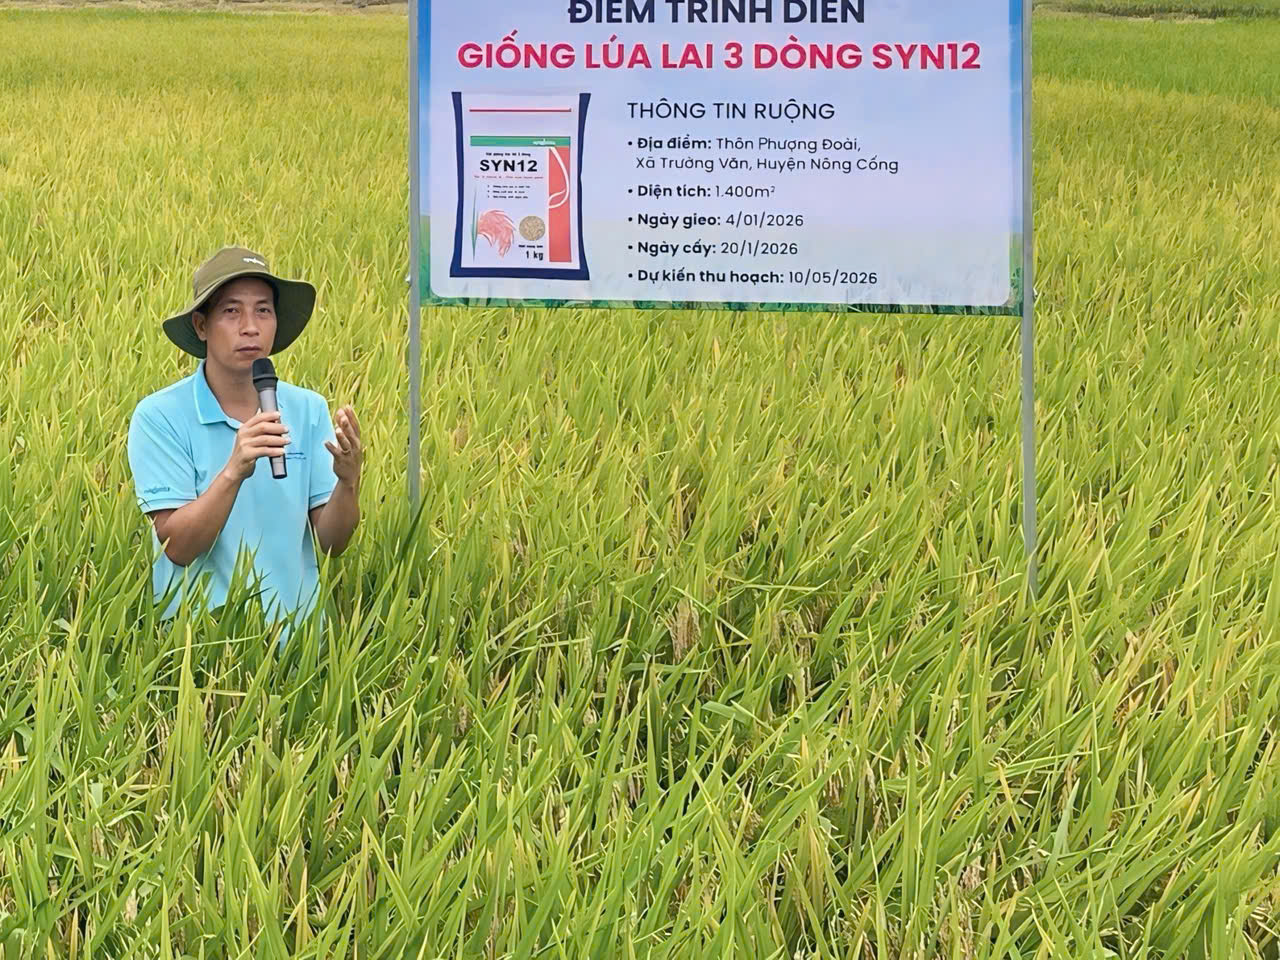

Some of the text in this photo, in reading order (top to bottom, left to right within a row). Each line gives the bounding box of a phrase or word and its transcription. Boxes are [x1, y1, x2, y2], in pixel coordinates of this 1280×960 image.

[457, 30, 982, 70] GIỐNG LÚA LAI 3 DÒNG SYN12
[627, 98, 836, 123] THÔNG TIN RUỘNG
[637, 133, 861, 154] Địa điểm: Thôn Phượng Đoài,
[479, 159, 538, 172] SYN12
[636, 155, 899, 173] Xã Trường Văn, Huyện Nông Cống
[637, 185, 672, 200] Diện
[676, 184, 711, 198] tích:
[637, 211, 804, 229] Ngày gieo: 4/01/2026
[637, 239, 798, 257] Ngày cấy: 20/1/2026
[637, 267, 878, 286] Dự kiến thu hoạch: 10/05/2026
